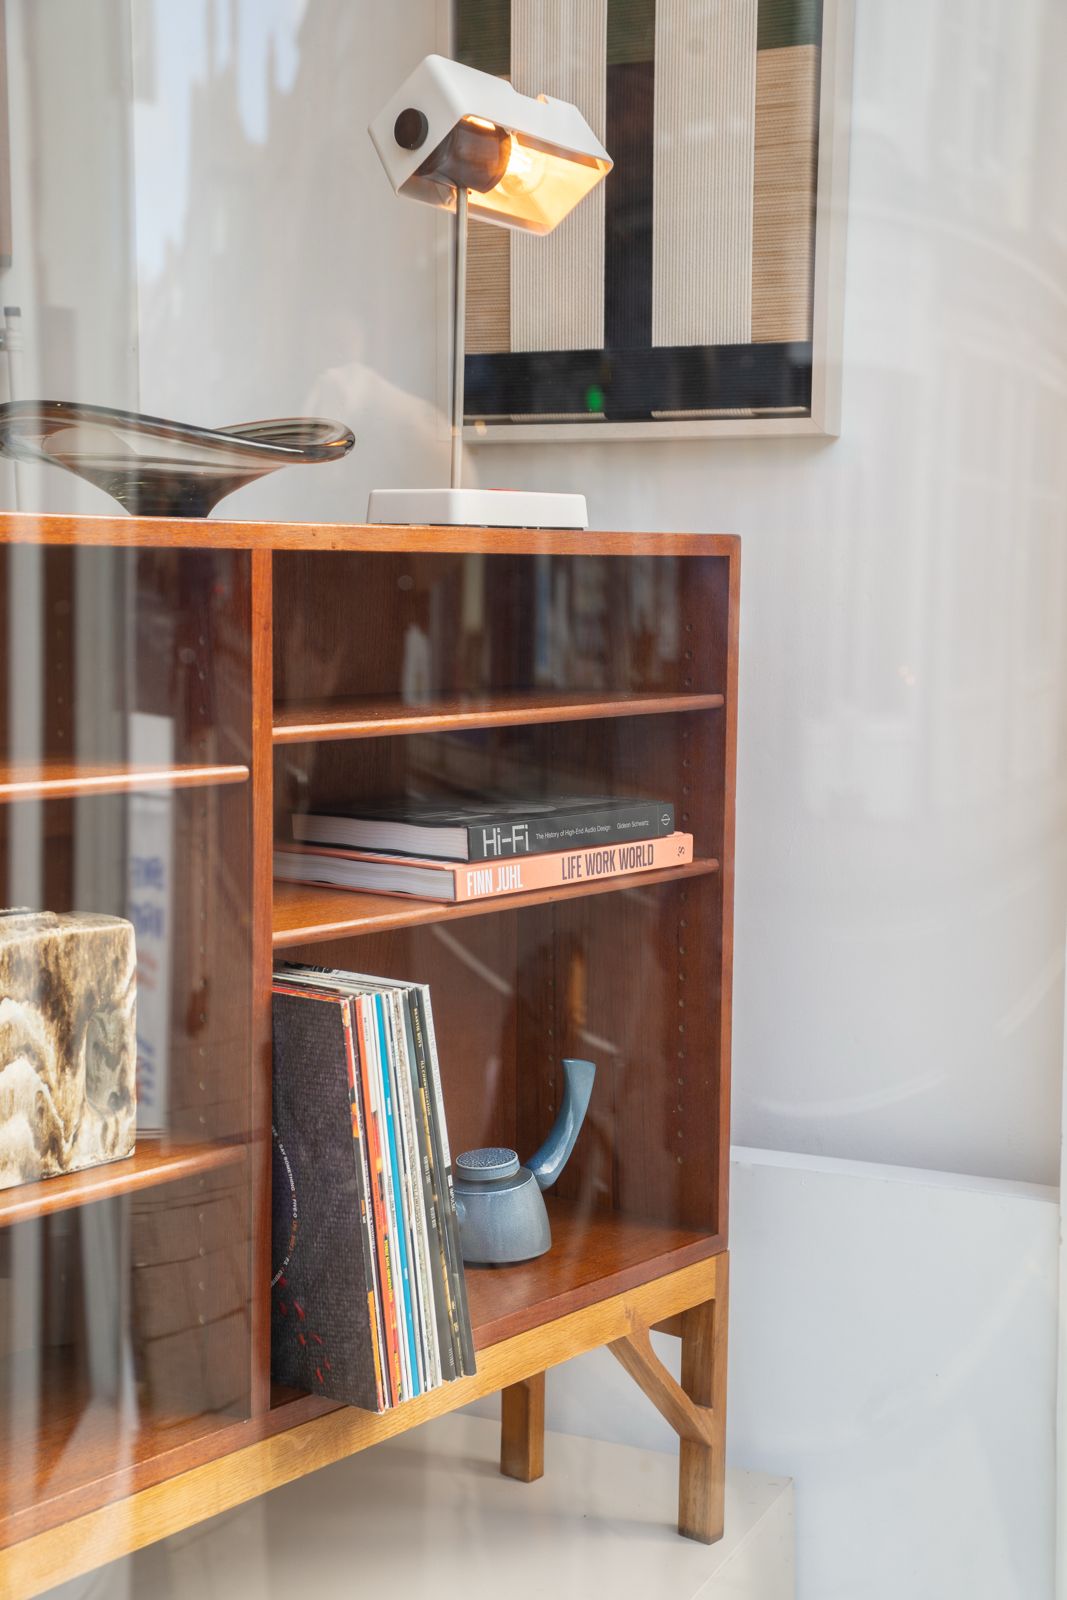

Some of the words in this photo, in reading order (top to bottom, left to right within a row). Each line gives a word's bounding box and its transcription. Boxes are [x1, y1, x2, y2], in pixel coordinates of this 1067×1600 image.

[482, 824, 530, 857] Hi-Fi
[535, 832, 544, 840] The
[544, 830, 560, 840] History
[560, 829, 565, 837] of
[564, 827, 584, 838] High-End
[584, 825, 597, 834] Audio
[597, 824, 611, 833] Design
[616, 821, 631, 830] Gideon
[631, 819, 649, 829] Schwartz
[561, 854, 583, 881] LIFE
[585, 849, 616, 877] WORK
[618, 843, 655, 871] WORLD
[466, 868, 494, 897] FINN
[496, 864, 524, 892] JUHL
[283, 1155, 296, 1192] SOMETHING
